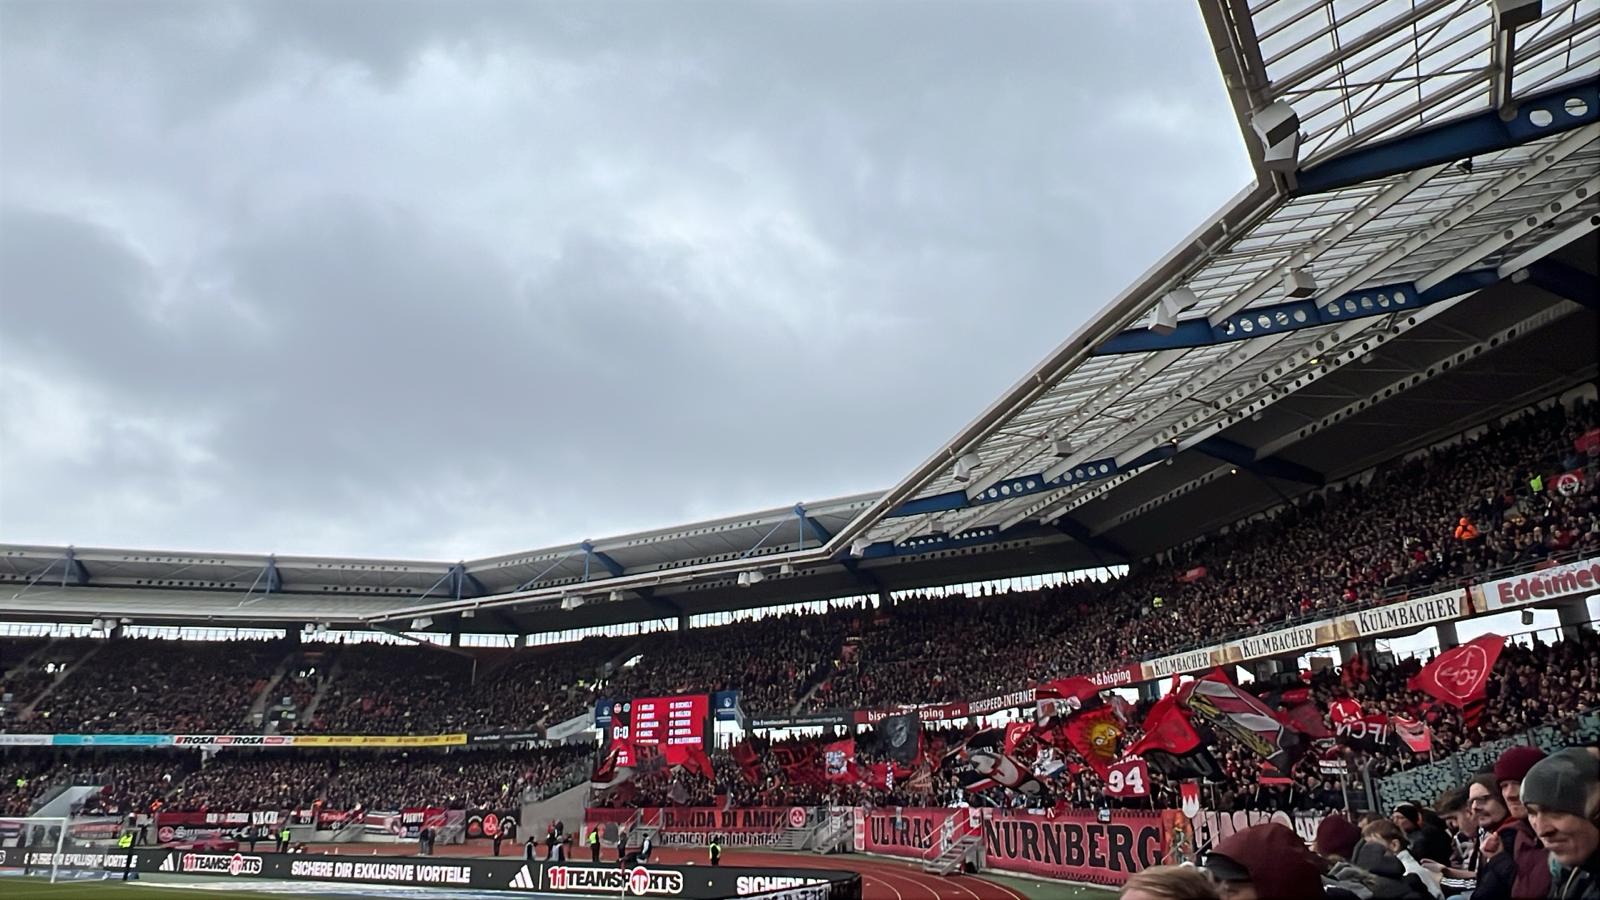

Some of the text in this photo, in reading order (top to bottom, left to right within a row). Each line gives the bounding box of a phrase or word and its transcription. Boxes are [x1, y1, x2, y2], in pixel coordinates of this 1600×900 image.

[1359, 597, 1457, 632] KULMBACHER
[1242, 628, 1313, 657] KULMBACHER
[1102, 669, 1132, 686] bisping
[969, 688, 1036, 714] HIGHSPEED-INTERNET
[182, 736, 215, 744] ROSA
[233, 736, 264, 744] ROSA
[613, 726, 629, 739] 0:0
[1108, 766, 1145, 793] 94
[871, 817, 934, 849] ULTRAS
[291, 861, 471, 883] SICHERE DIR EXKLUSIVE VORTEILE
